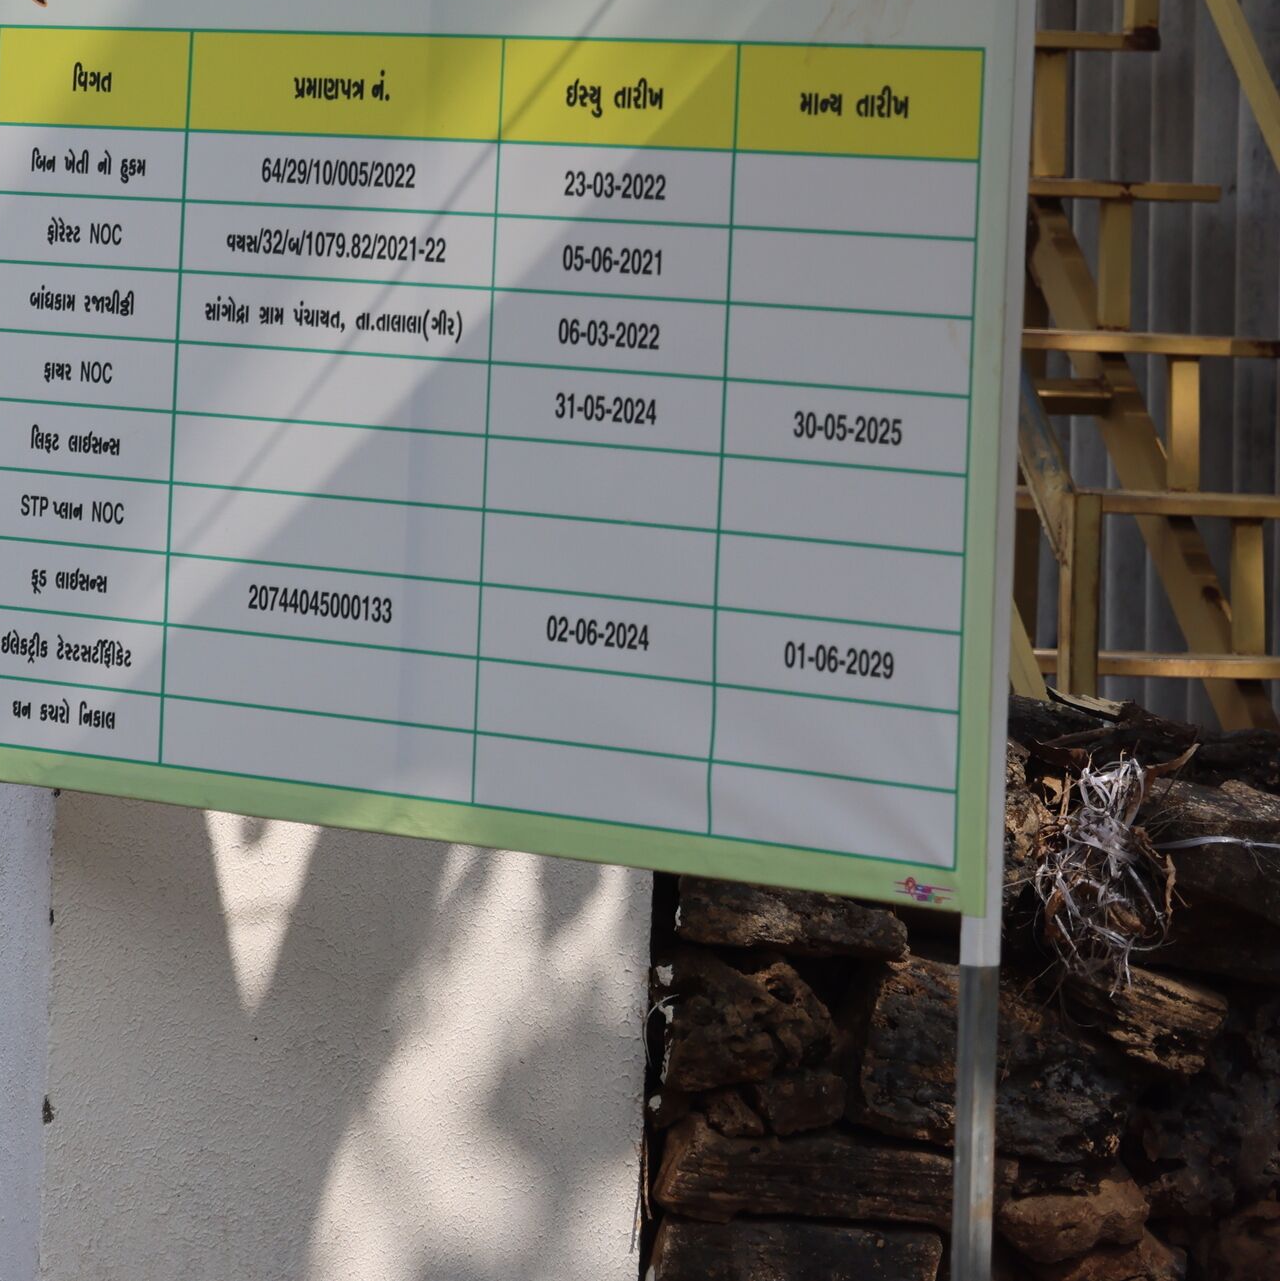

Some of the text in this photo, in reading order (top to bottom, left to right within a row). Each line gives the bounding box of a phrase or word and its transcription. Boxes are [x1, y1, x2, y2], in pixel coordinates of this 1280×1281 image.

[72, 61, 112, 93] વિગત
[293, 69, 390, 102] પ્રમાણપત્ર નં.
[613, 77, 664, 110] તારીખ
[800, 85, 909, 119] માન્ય તારીખ
[31, 147, 146, 184] બિન ખેતી નો હુકમ
[261, 157, 416, 189] 64/29/10/005/2022
[564, 170, 667, 201] 23-03-2022
[47, 216, 123, 246] ફોરેસ્ટ NOC
[562, 244, 662, 276] 05-06-2021
[29, 284, 76, 312] બાંધકામ
[204, 295, 250, 325] સાંગોદ્રા
[258, 306, 284, 325] ગ્રામ
[293, 300, 346, 333] પંચાયત,
[558, 318, 660, 350] 06-03-2022
[43, 360, 113, 385] ફાયર NOC
[555, 392, 657, 425] 31-05-2024
[793, 410, 903, 446] 30-05-2025
[20, 494, 125, 525] STP પ્લાન NOC
[31, 568, 47, 594] ફૂડ
[247, 584, 392, 624] 20744045000133
[546, 615, 650, 651] 02-06-2024
[784, 640, 894, 680] 01-06-2029
[39, 698, 70, 724] કચરો
[78, 700, 116, 730] નિકાલ
